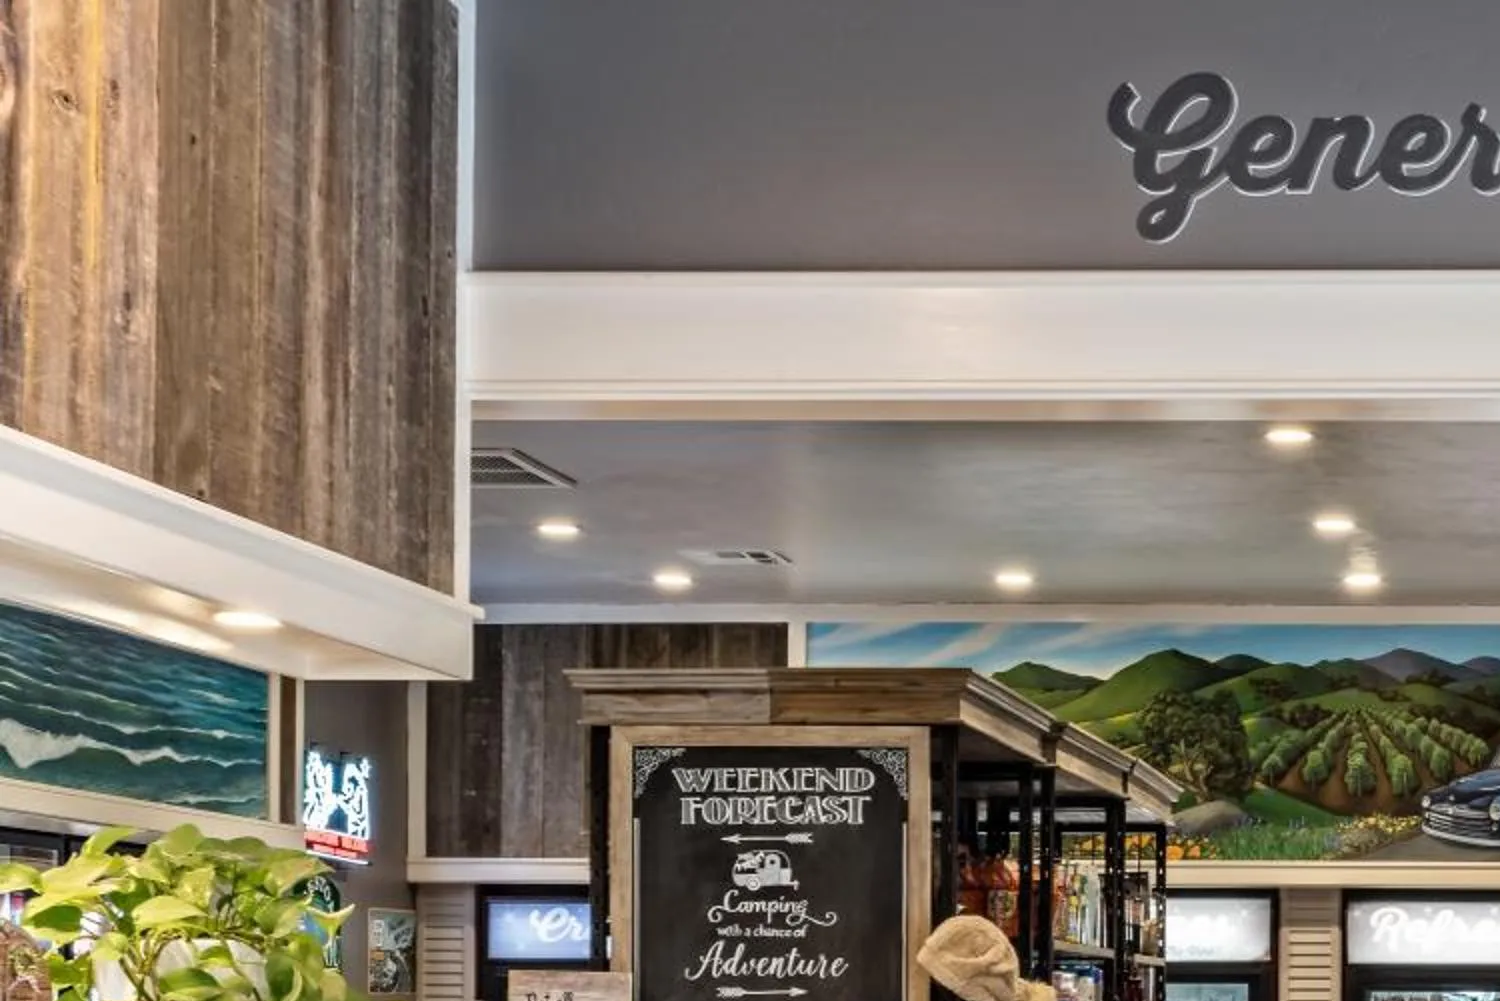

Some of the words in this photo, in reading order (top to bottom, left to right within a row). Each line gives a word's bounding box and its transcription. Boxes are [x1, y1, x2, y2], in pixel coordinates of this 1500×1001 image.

[671, 767, 876, 793] WEEKEND
[680, 796, 872, 826] FORECAST
[706, 888, 838, 927] Camping
[684, 940, 849, 981] Adventure
